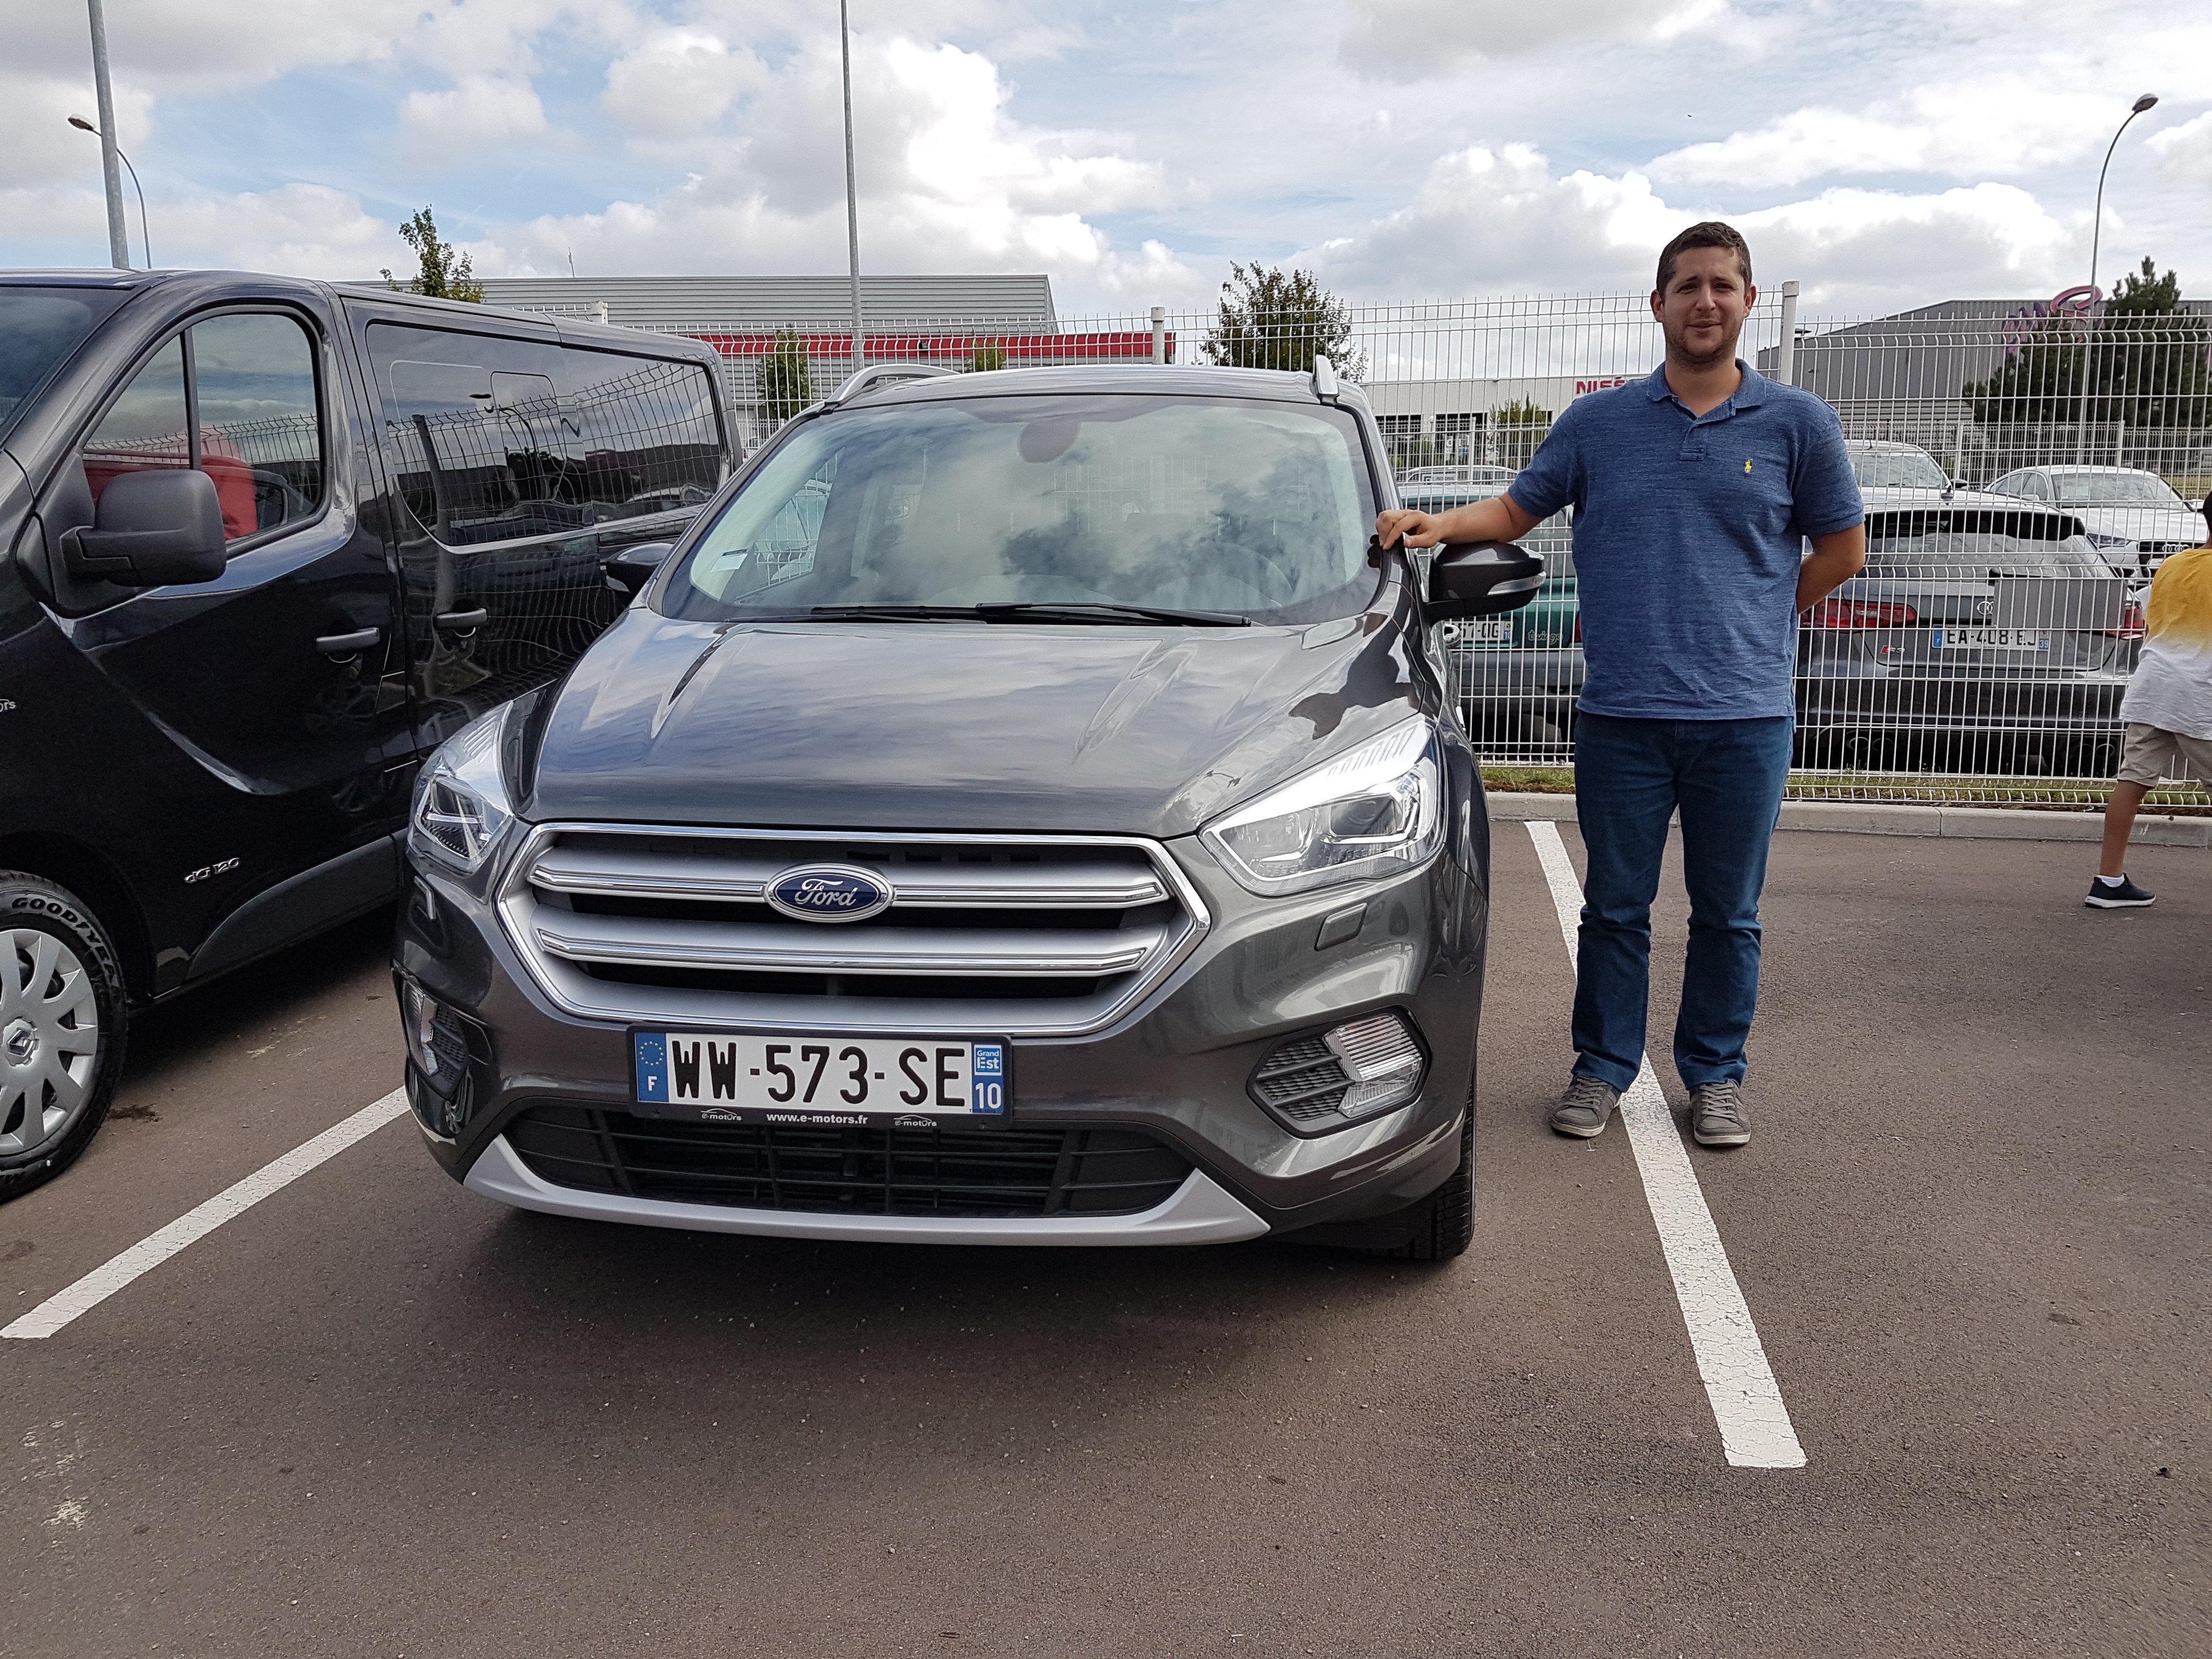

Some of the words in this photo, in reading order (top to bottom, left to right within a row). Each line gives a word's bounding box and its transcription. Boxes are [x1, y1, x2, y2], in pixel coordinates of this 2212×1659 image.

[2039, 640, 2049, 648] 39
[795, 879, 859, 906] Ford
[977, 1057, 1000, 1069] Est
[672, 1040, 966, 1107] WW-573-SE
[647, 1076, 657, 1091] F
[975, 1082, 1001, 1109] 10
[766, 1114, 868, 1124] www.e-motors.fr
